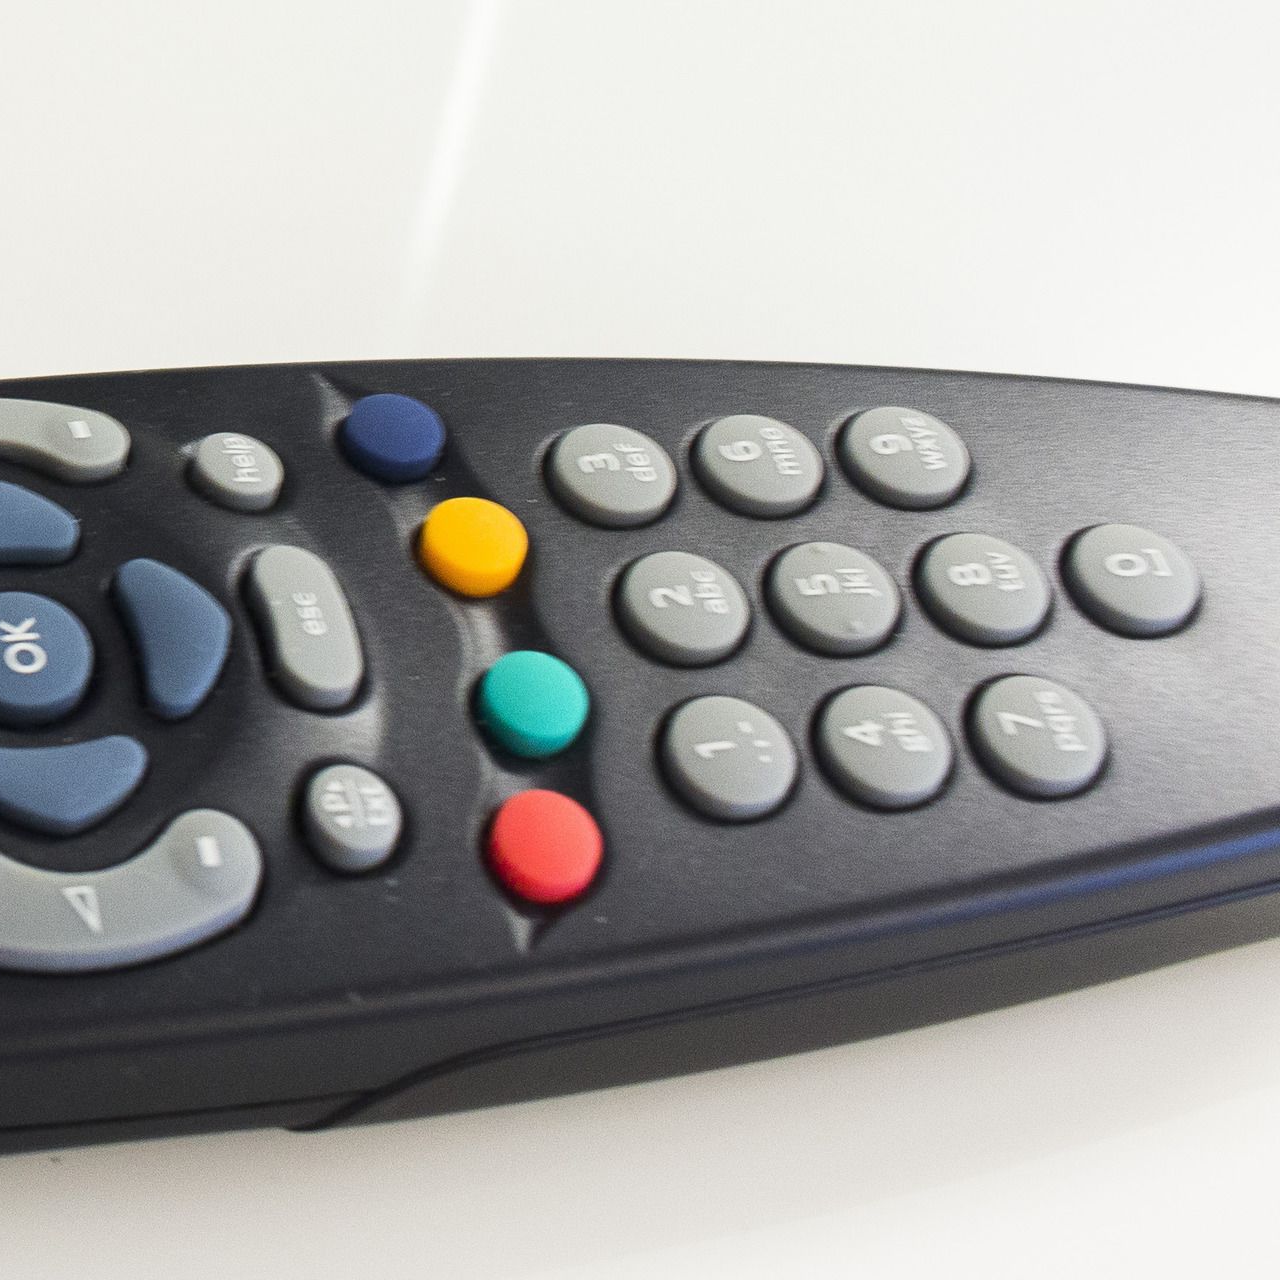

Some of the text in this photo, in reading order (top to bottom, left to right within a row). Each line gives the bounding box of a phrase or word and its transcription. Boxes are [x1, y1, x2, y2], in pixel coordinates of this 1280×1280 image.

[717, 438, 763, 465] 6
[760, 426, 805, 477] mno
[867, 430, 915, 456] 9
[899, 415, 949, 473] wxyz
[221, 434, 264, 484] help
[576, 450, 621, 475] 3
[616, 441, 658, 484] def
[946, 560, 995, 588] 8
[984, 549, 1028, 594] tuv
[1102, 549, 1153, 579] 0
[649, 582, 697, 610] 2
[689, 567, 733, 616] abc
[795, 572, 842, 600] 5
[838, 565, 885, 599] jkl
[290, 588, 332, 639] esc
[840, 716, 886, 748] 4
[993, 709, 1044, 740] 7
[692, 738, 739, 761] 1
